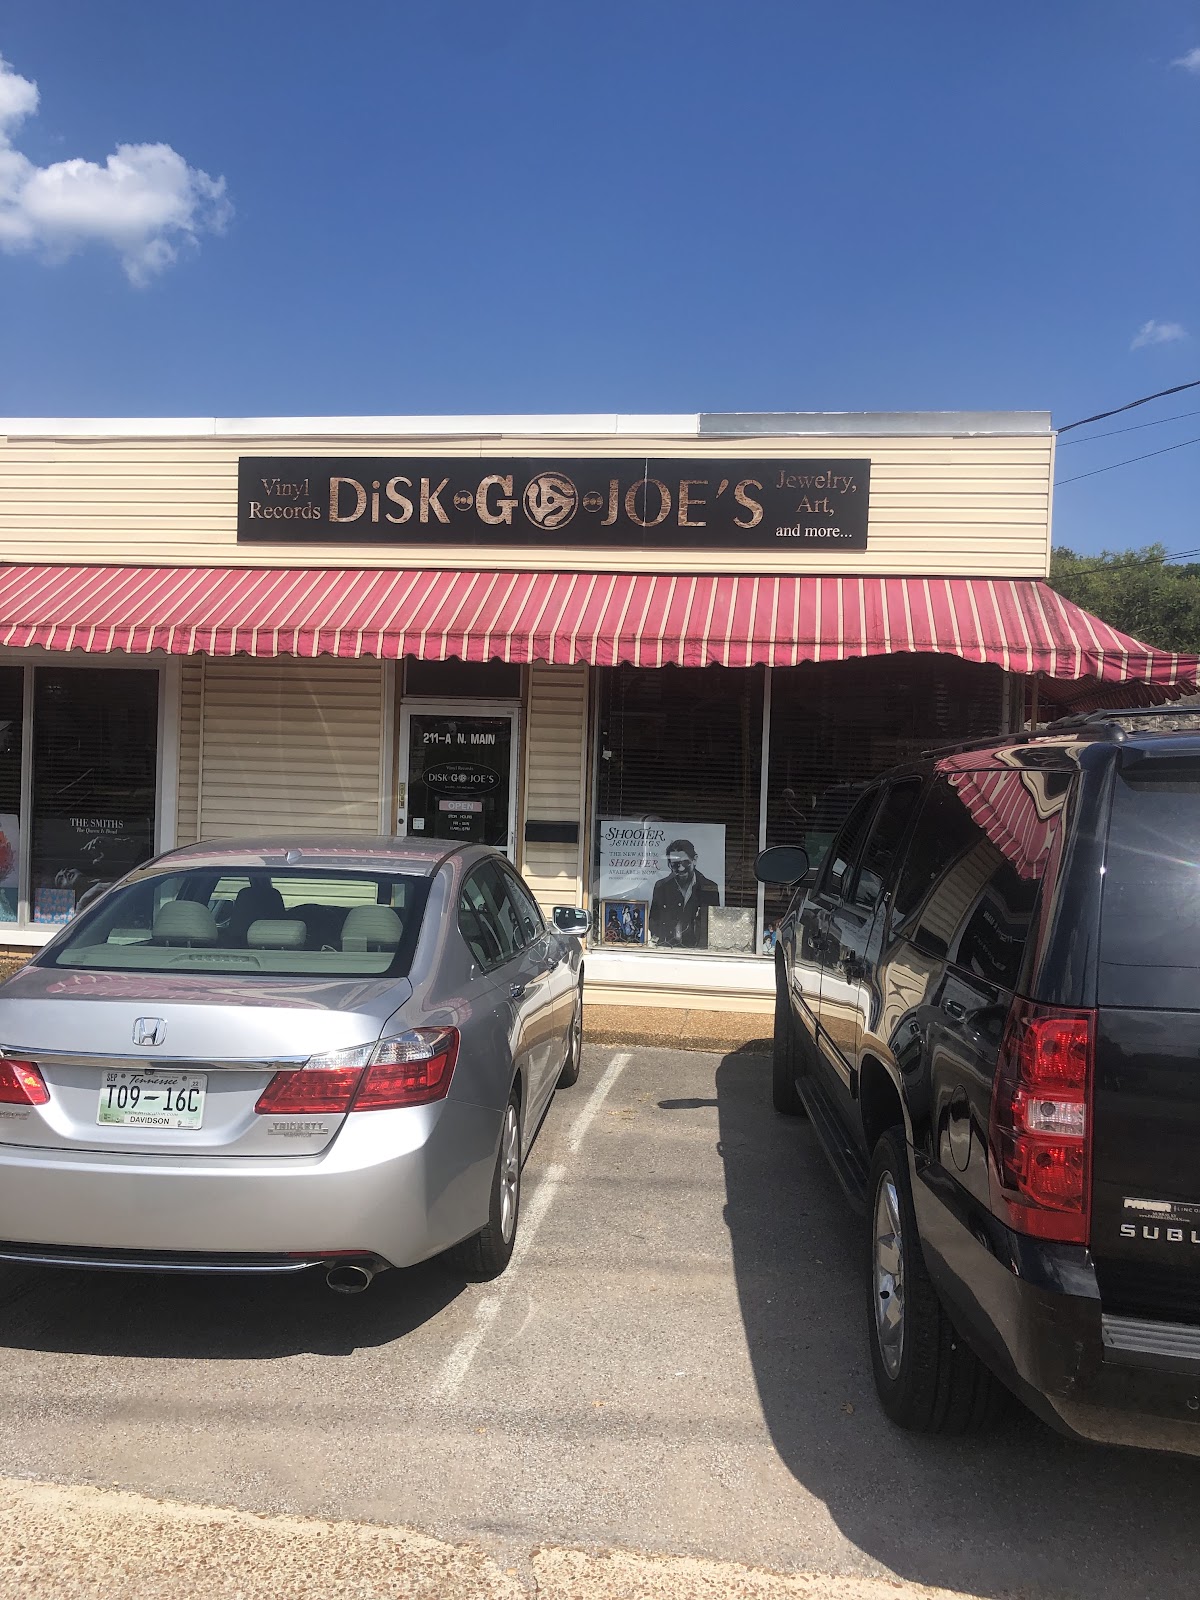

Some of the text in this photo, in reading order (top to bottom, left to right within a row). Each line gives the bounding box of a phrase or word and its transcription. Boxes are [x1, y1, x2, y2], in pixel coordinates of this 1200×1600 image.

[776, 469, 858, 494] Jewelry,
[261, 478, 310, 501] Vinyl
[601, 478, 764, 529] JOE'S
[796, 495, 836, 517] Art,
[248, 501, 321, 520] Records
[776, 524, 853, 538] and more...
[423, 733, 496, 745] 211-A N. MAIN
[470, 774, 495, 784] JOE'S
[448, 802, 474, 810] OPEN
[69, 817, 124, 829] THE SMITHS
[605, 827, 666, 841] SHOOTER
[609, 858, 661, 870] SHOOTER
[106, 1073, 118, 1082] SEP
[129, 1074, 178, 1085] Tennessee
[130, 1116, 170, 1125] DAVIDSON
